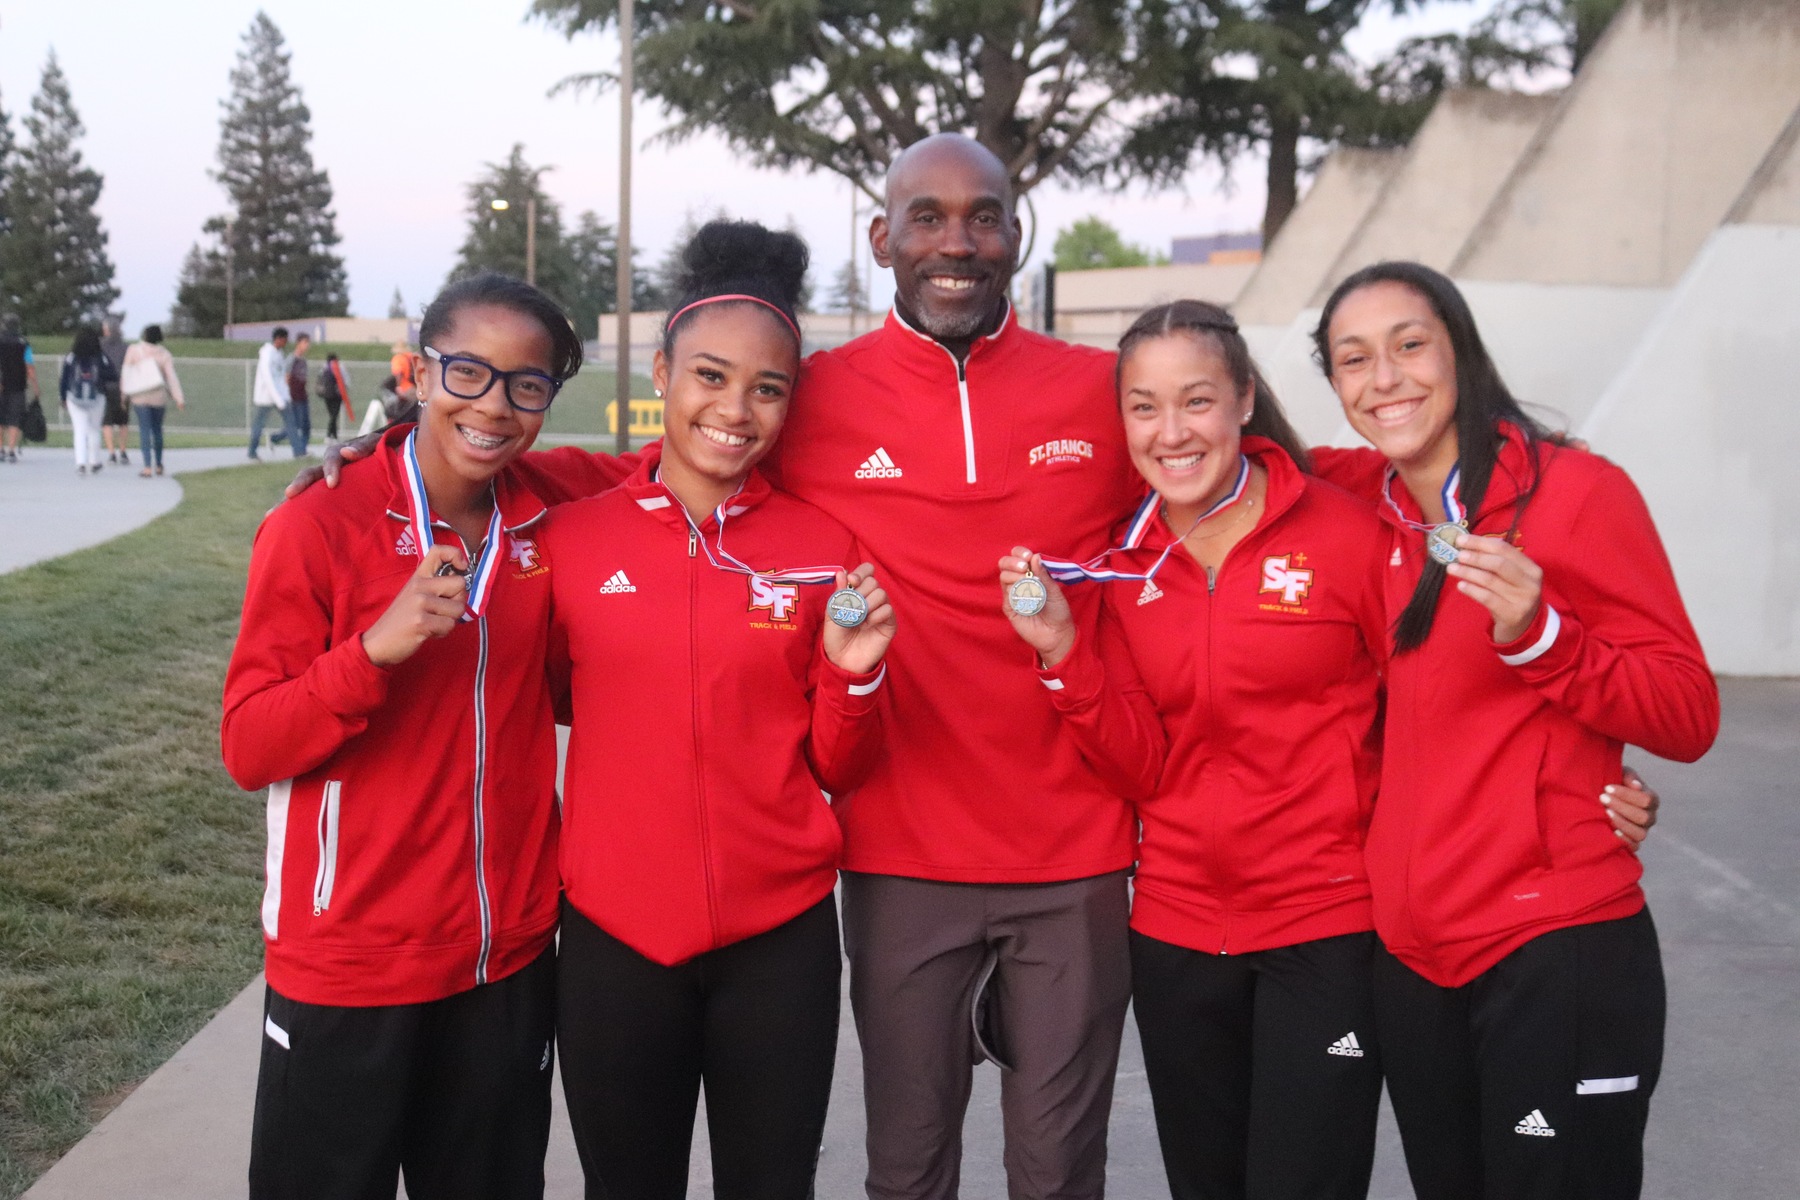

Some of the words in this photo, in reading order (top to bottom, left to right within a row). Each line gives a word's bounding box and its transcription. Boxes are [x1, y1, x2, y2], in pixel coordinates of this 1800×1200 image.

[1045, 439, 1093, 458] FRANCIS
[1046, 455, 1080, 465] ATHLETICS
[854, 466, 903, 479] adidas
[395, 544, 418, 555] adid
[1262, 556, 1311, 604] SF
[600, 584, 637, 594] adidas
[750, 574, 797, 620] SF
[1137, 589, 1164, 605] adidas
[834, 609, 861, 622] SJS
[778, 623, 798, 631] FIELD
[1327, 1046, 1364, 1057] adidas
[1514, 1125, 1556, 1137] adidas
